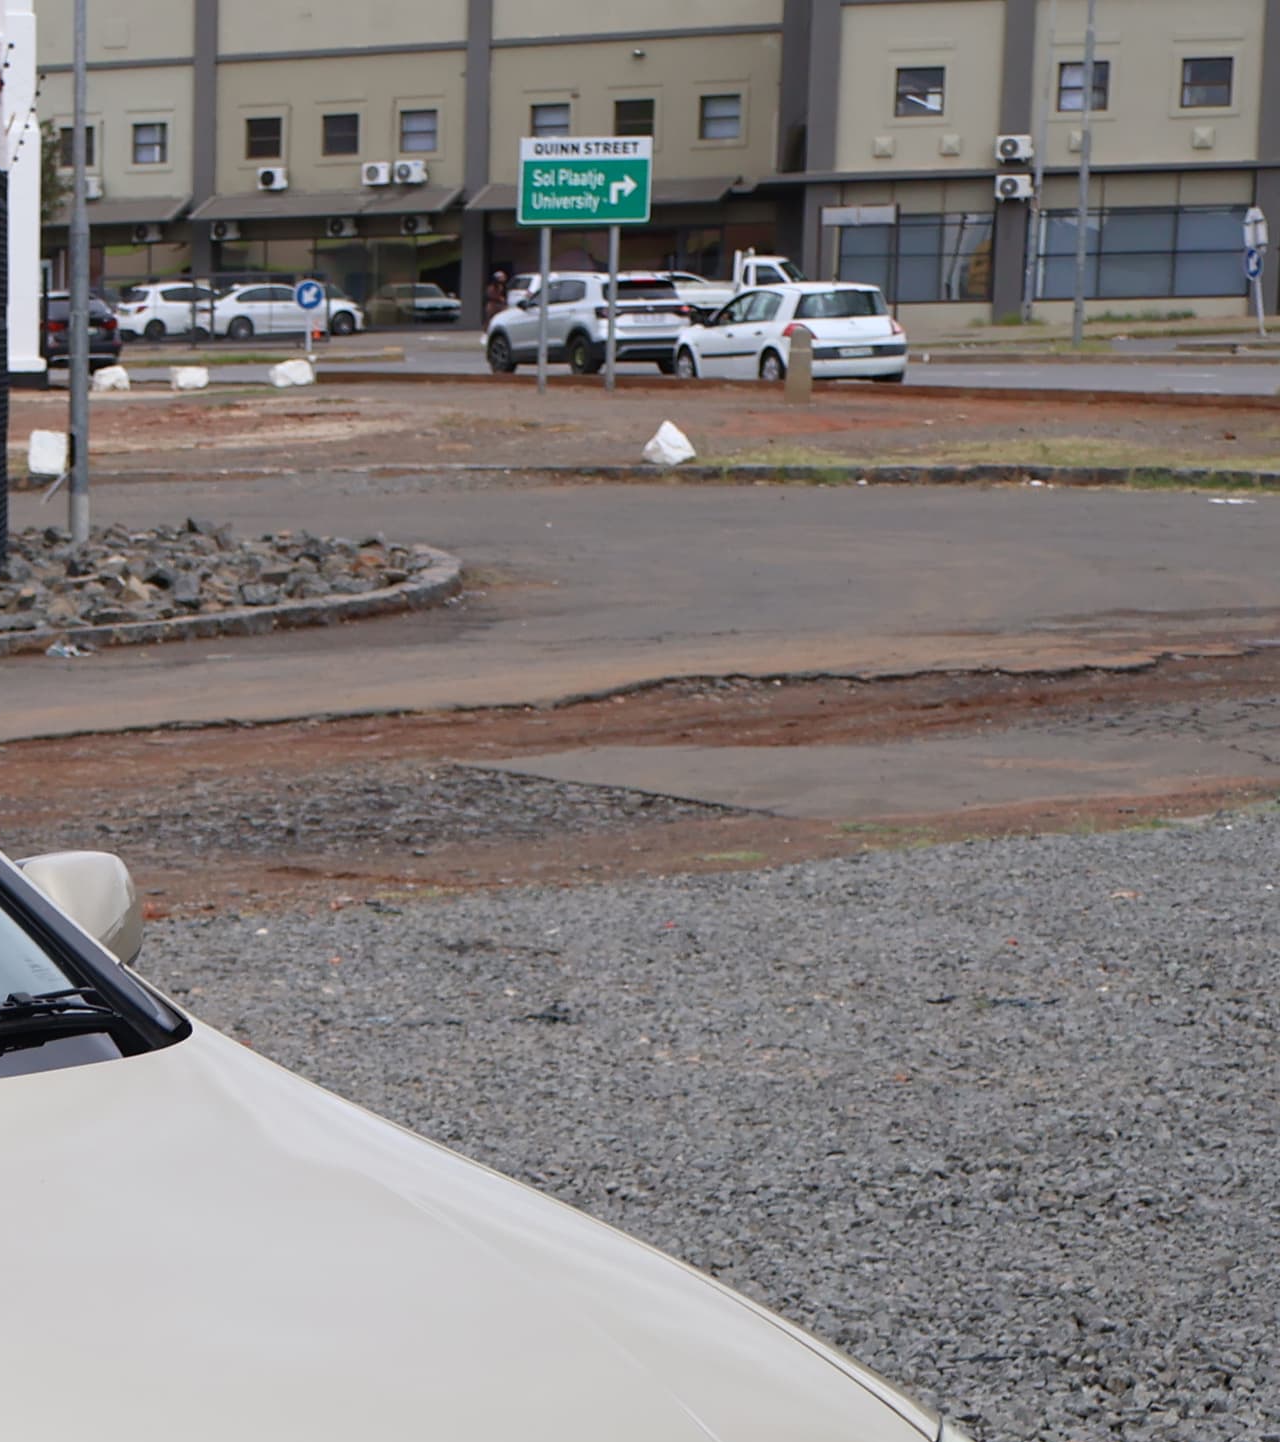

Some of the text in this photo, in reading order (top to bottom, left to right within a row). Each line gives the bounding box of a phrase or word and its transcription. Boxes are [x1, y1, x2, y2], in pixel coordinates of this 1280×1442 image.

[534, 141, 639, 156] QUINN STREET
[532, 168, 605, 190] Sol Plaatje
[531, 191, 600, 213] University
